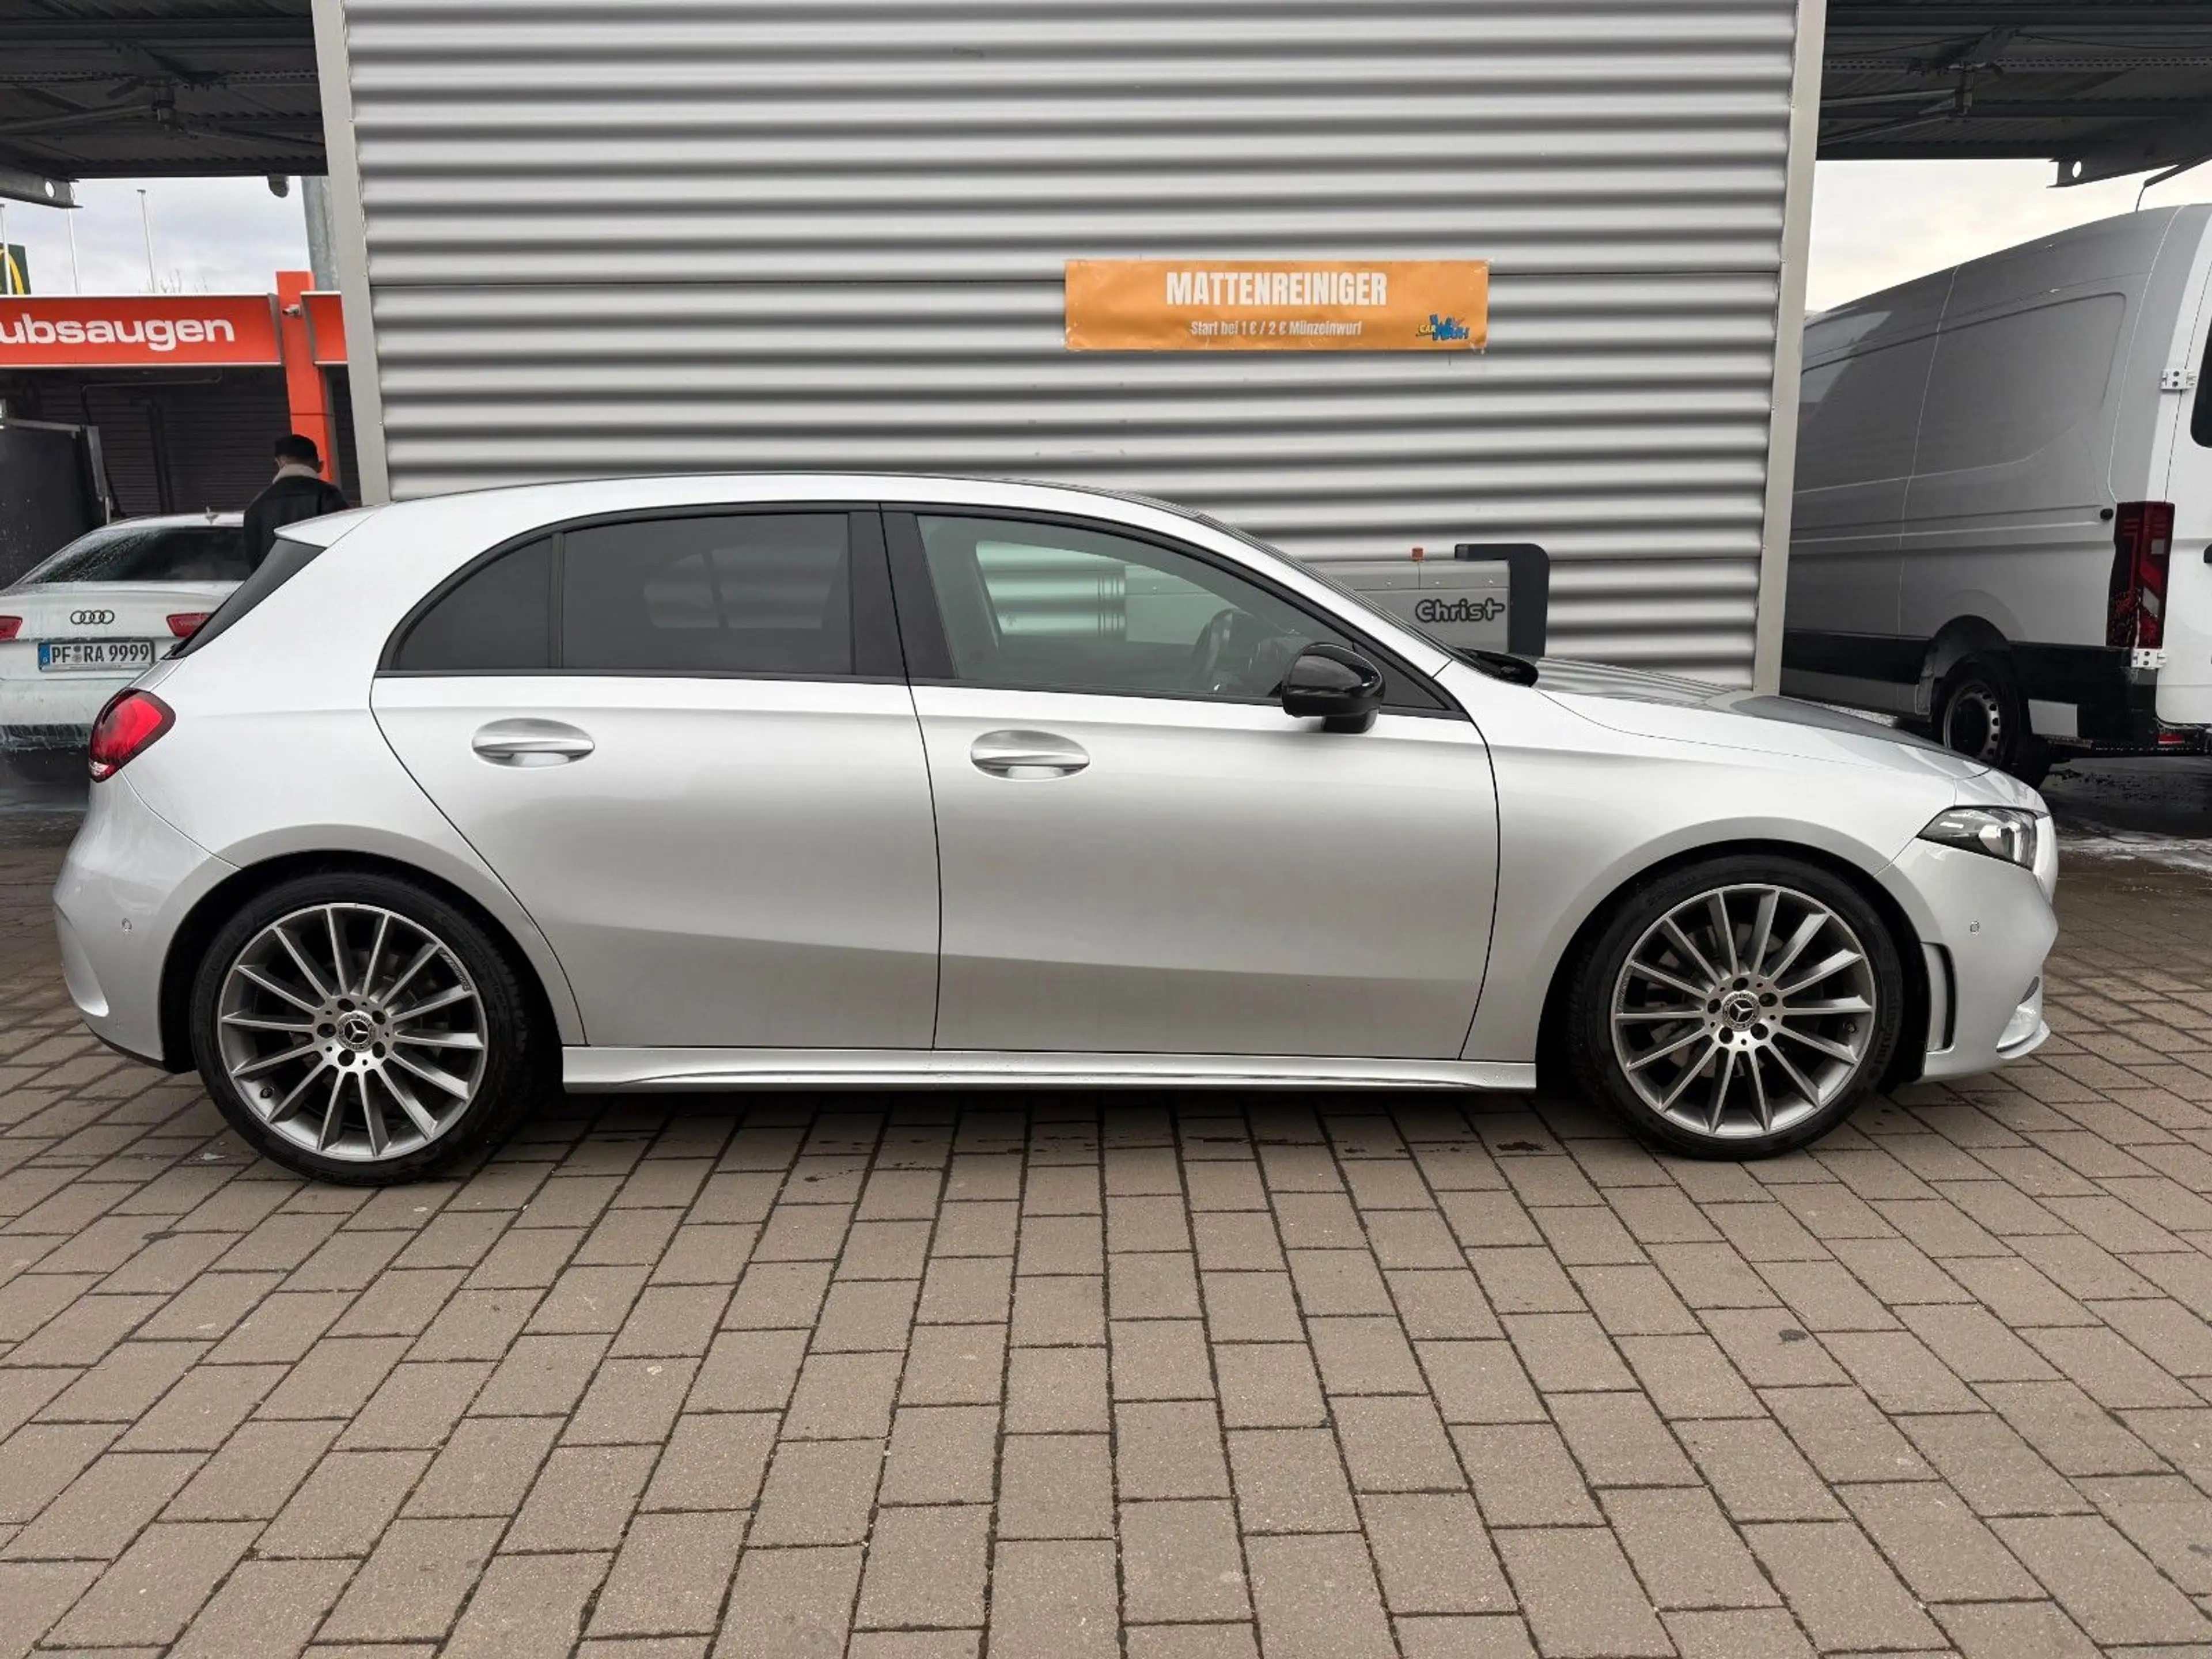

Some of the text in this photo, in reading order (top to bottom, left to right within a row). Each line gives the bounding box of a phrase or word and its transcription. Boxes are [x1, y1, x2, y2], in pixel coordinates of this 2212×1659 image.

[1166, 271, 1388, 306] MATTENREINIGER
[0, 313, 234, 351] ubsaugen
[1191, 320, 1218, 335] Start
[1221, 320, 1238, 335] bei
[1241, 321, 1247, 335] 1
[1259, 320, 1266, 335] /
[1268, 320, 1276, 335] 2
[1289, 319, 1362, 336] Münzeinwurf
[1415, 597, 1505, 623] Christ
[52, 647, 71, 663] PF
[84, 645, 104, 662] RA
[109, 644, 149, 662] 9999
